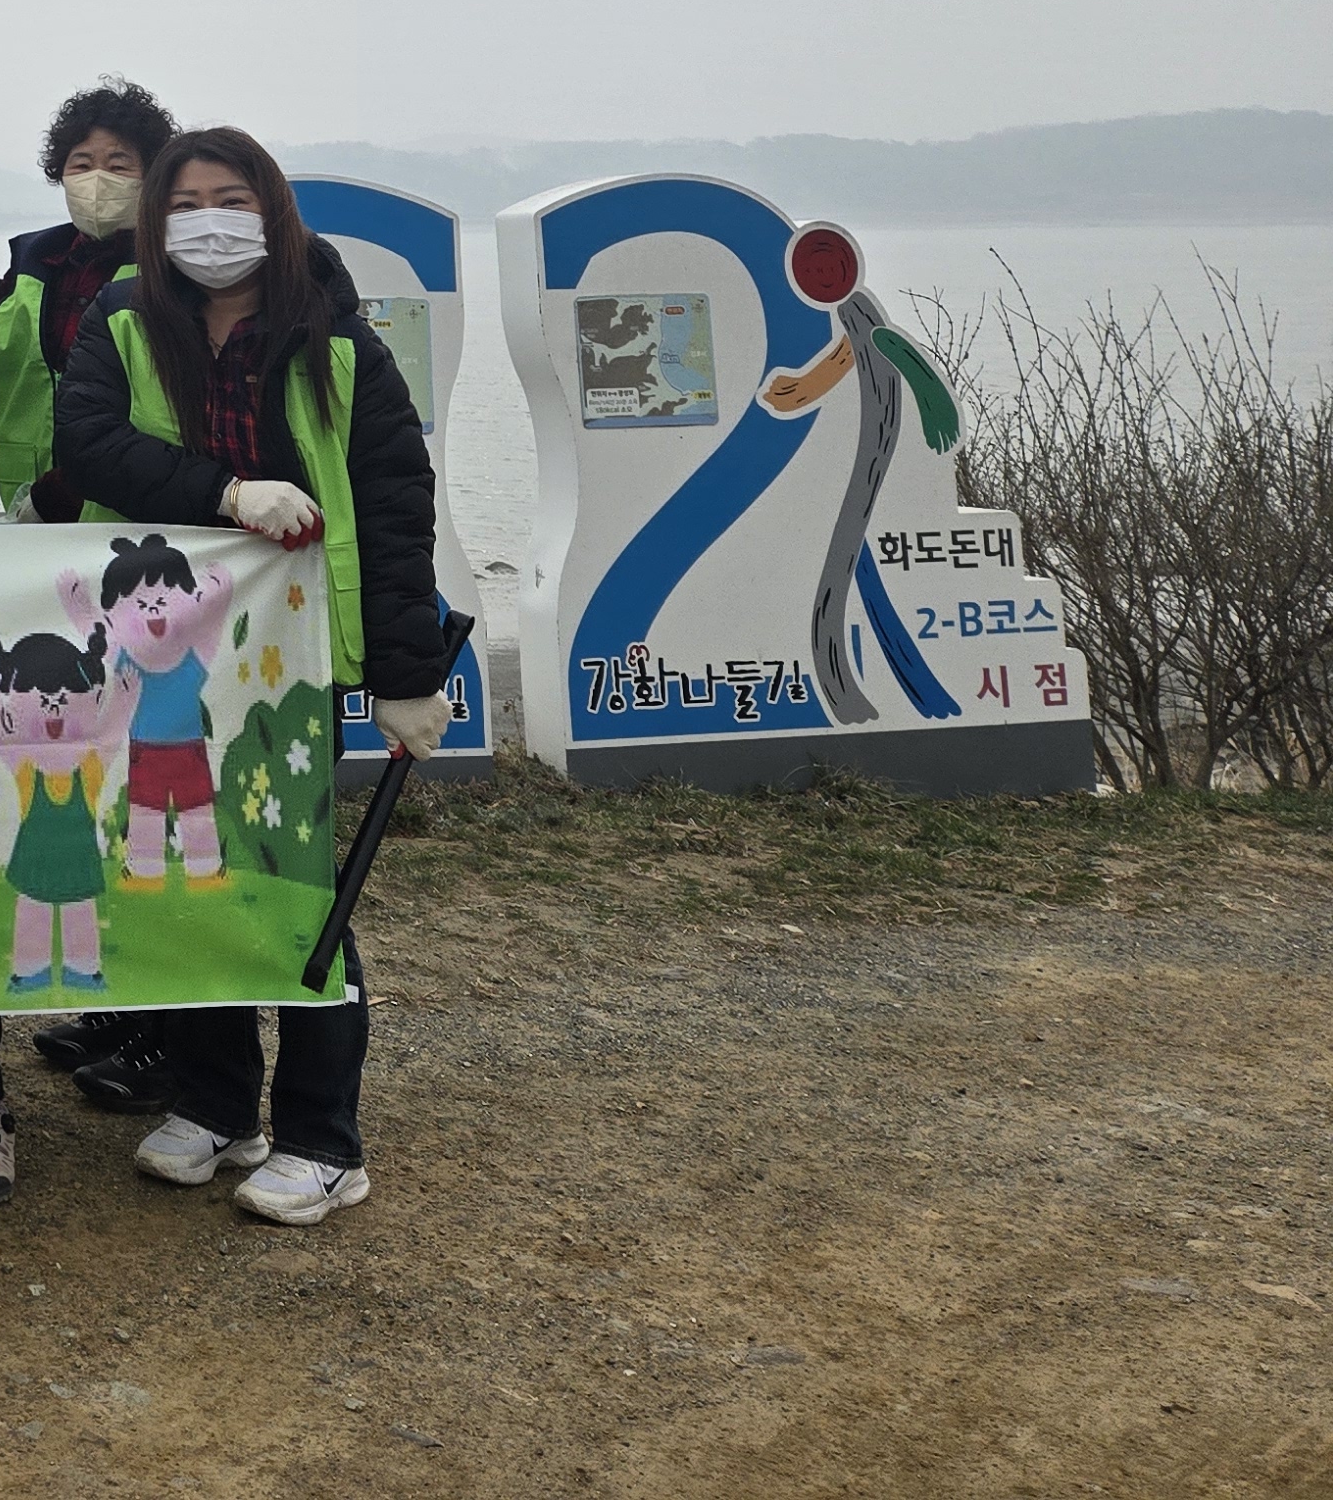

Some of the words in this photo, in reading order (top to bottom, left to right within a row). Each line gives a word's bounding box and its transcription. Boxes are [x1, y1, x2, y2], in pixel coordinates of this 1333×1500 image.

[878, 528, 1015, 571] 화도돈대
[916, 598, 1058, 640] 2-B코스
[582, 652, 808, 721] 강화나들길
